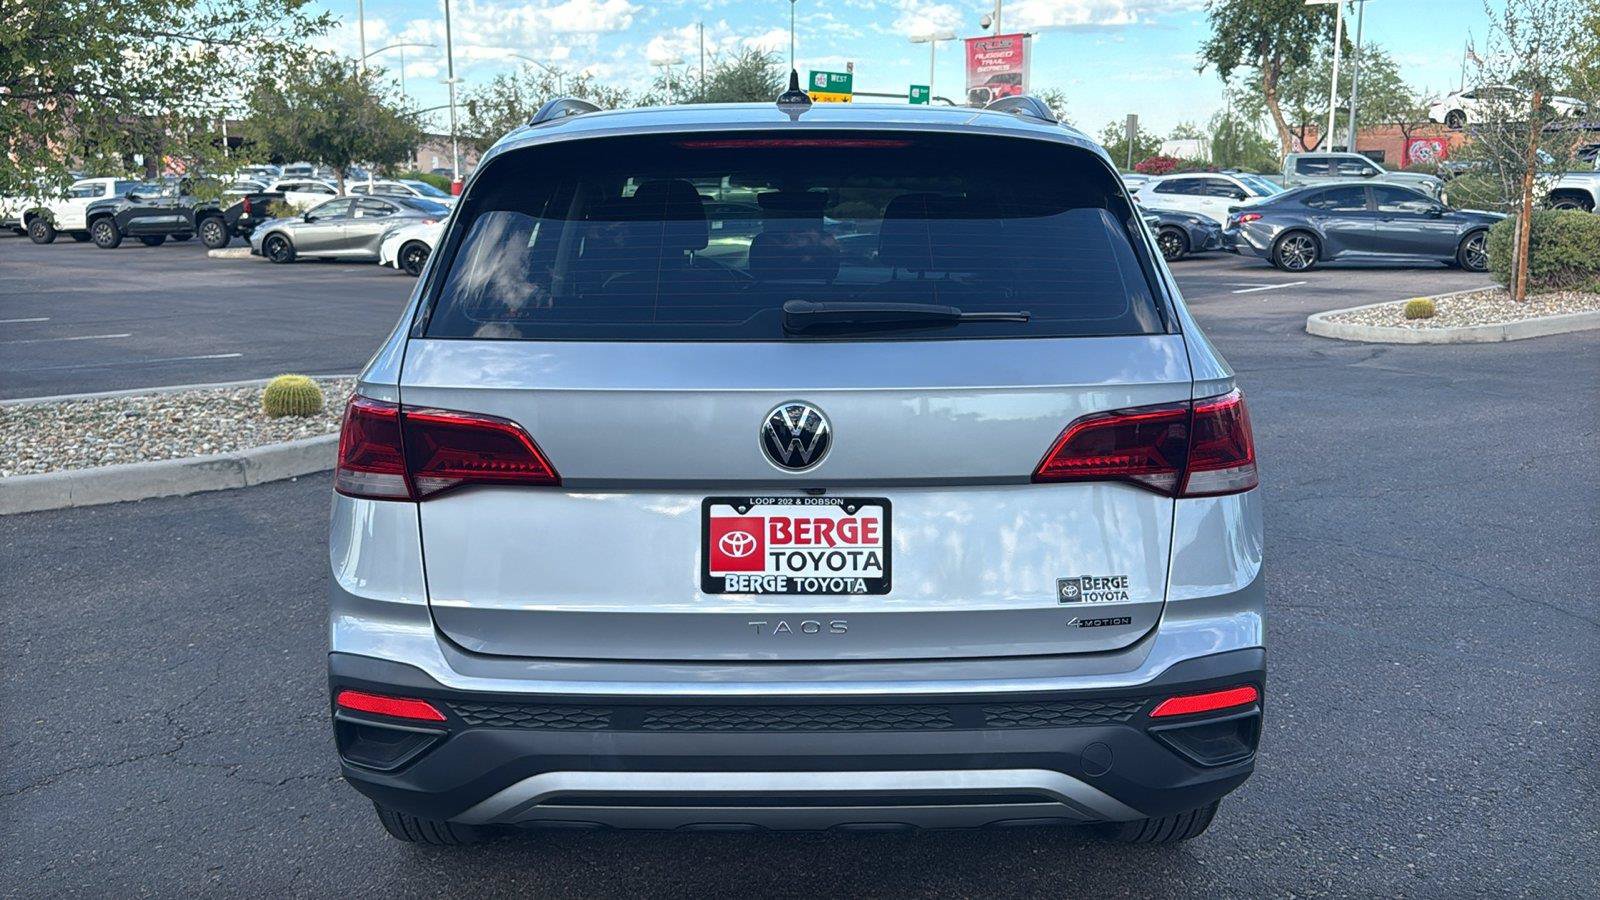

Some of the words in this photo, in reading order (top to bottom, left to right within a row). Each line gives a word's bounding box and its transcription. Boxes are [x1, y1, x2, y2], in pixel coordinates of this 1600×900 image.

[769, 517, 879, 548] BERGE
[769, 551, 882, 572] TOYOTA
[725, 574, 788, 593] BERGE
[794, 578, 868, 593] TOYOTA
[1082, 576, 1129, 590] BERGE
[1082, 591, 1129, 603] TOYOTA
[748, 620, 848, 635] TAOS
